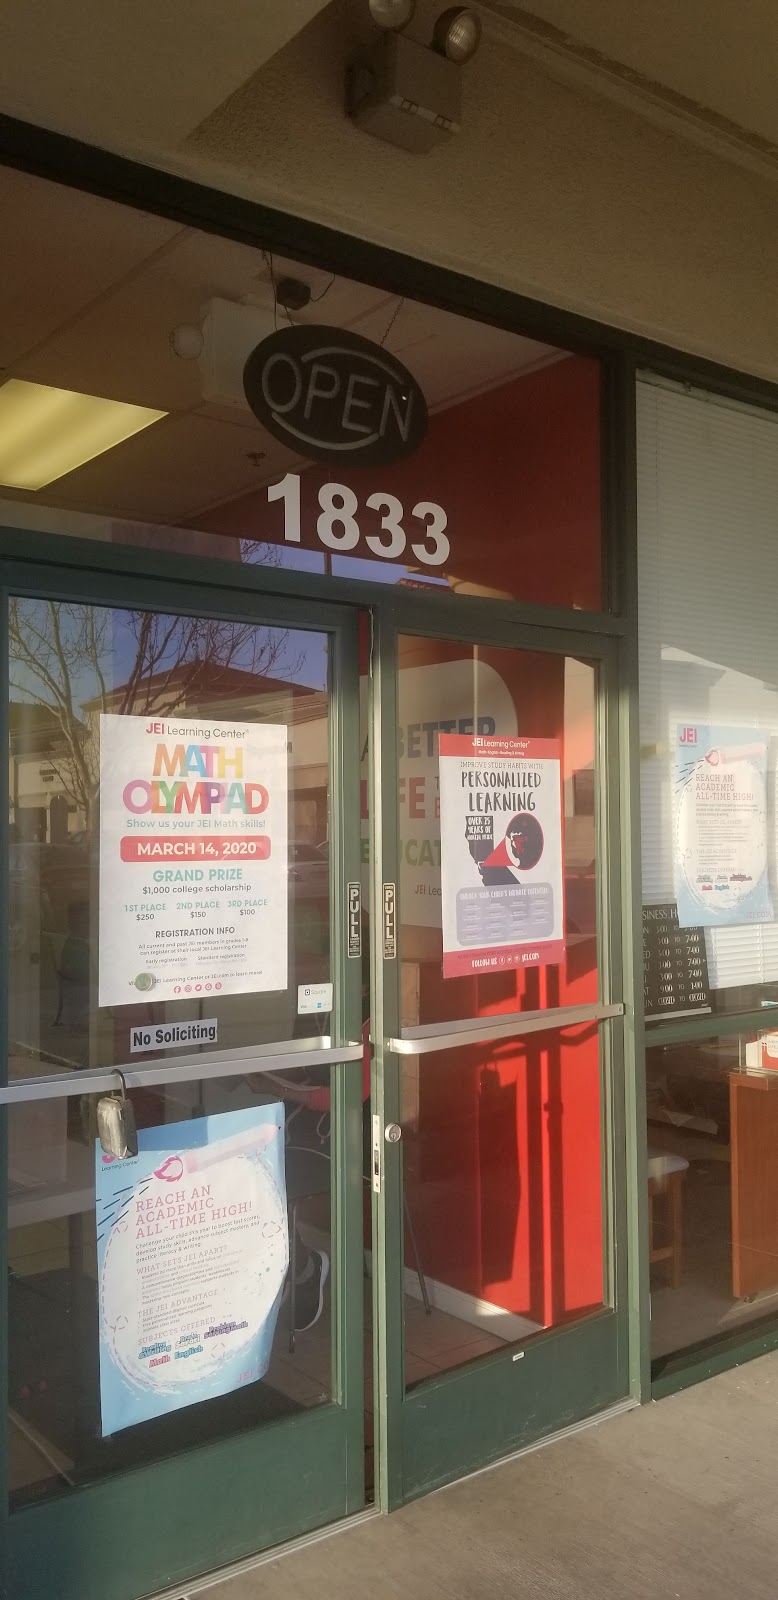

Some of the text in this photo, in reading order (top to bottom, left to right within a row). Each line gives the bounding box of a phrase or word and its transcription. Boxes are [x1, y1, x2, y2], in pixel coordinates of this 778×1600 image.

[262, 353, 413, 442] OPEN
[268, 472, 450, 565] 1833
[146, 723, 245, 739] JEI Learning Center
[680, 728, 697, 743] JEI
[472, 738, 528, 748] JEI Learning Center
[153, 744, 243, 778] MATH
[462, 771, 541, 789] PERSONALIZED
[696, 774, 733, 782] REACH AN
[696, 783, 734, 791] ACADEMIC
[123, 780, 269, 814] OLYMPIAD
[469, 792, 535, 813] LEARNING
[127, 819, 155, 828] Show
[172, 821, 194, 829] your
[197, 820, 210, 828] JEI
[468, 817, 482, 825] OVER
[468, 826, 483, 834] YEARS
[138, 842, 256, 856] MARCH 14, 2020
[153, 869, 242, 882] GRAND PRIZE
[143, 884, 251, 894] $1,000 college scholarship
[415, 885, 425, 894] JEI
[176, 901, 219, 910] 2ND PLACE
[245, 899, 267, 907] PLACE
[136, 913, 154, 921] $250
[350, 889, 359, 937] PULL
[385, 890, 393, 938] PULL
[642, 909, 667, 920] SINESS
[156, 928, 214, 938] REGISTRATION
[472, 957, 497, 967] FOLLOW US
[134, 1025, 216, 1046] No Soliciting
[102, 1162, 121, 1172] Learning
[136, 1185, 211, 1212] REACH AN
[136, 1198, 214, 1225] ACADEMIC
[136, 1201, 252, 1239] ALL-TIME HIGH!
[136, 1240, 161, 1249] Challenge
[158, 1243, 172, 1251] study
[137, 1245, 227, 1274] WHAT SETS JEI APART?
[138, 1289, 218, 1317] THE JEI ADVANTAGE
[138, 1329, 178, 1345] SUBJECTS
[181, 1317, 216, 1332] OFFERED
[175, 1345, 203, 1359] English
[149, 1355, 170, 1368] Math
